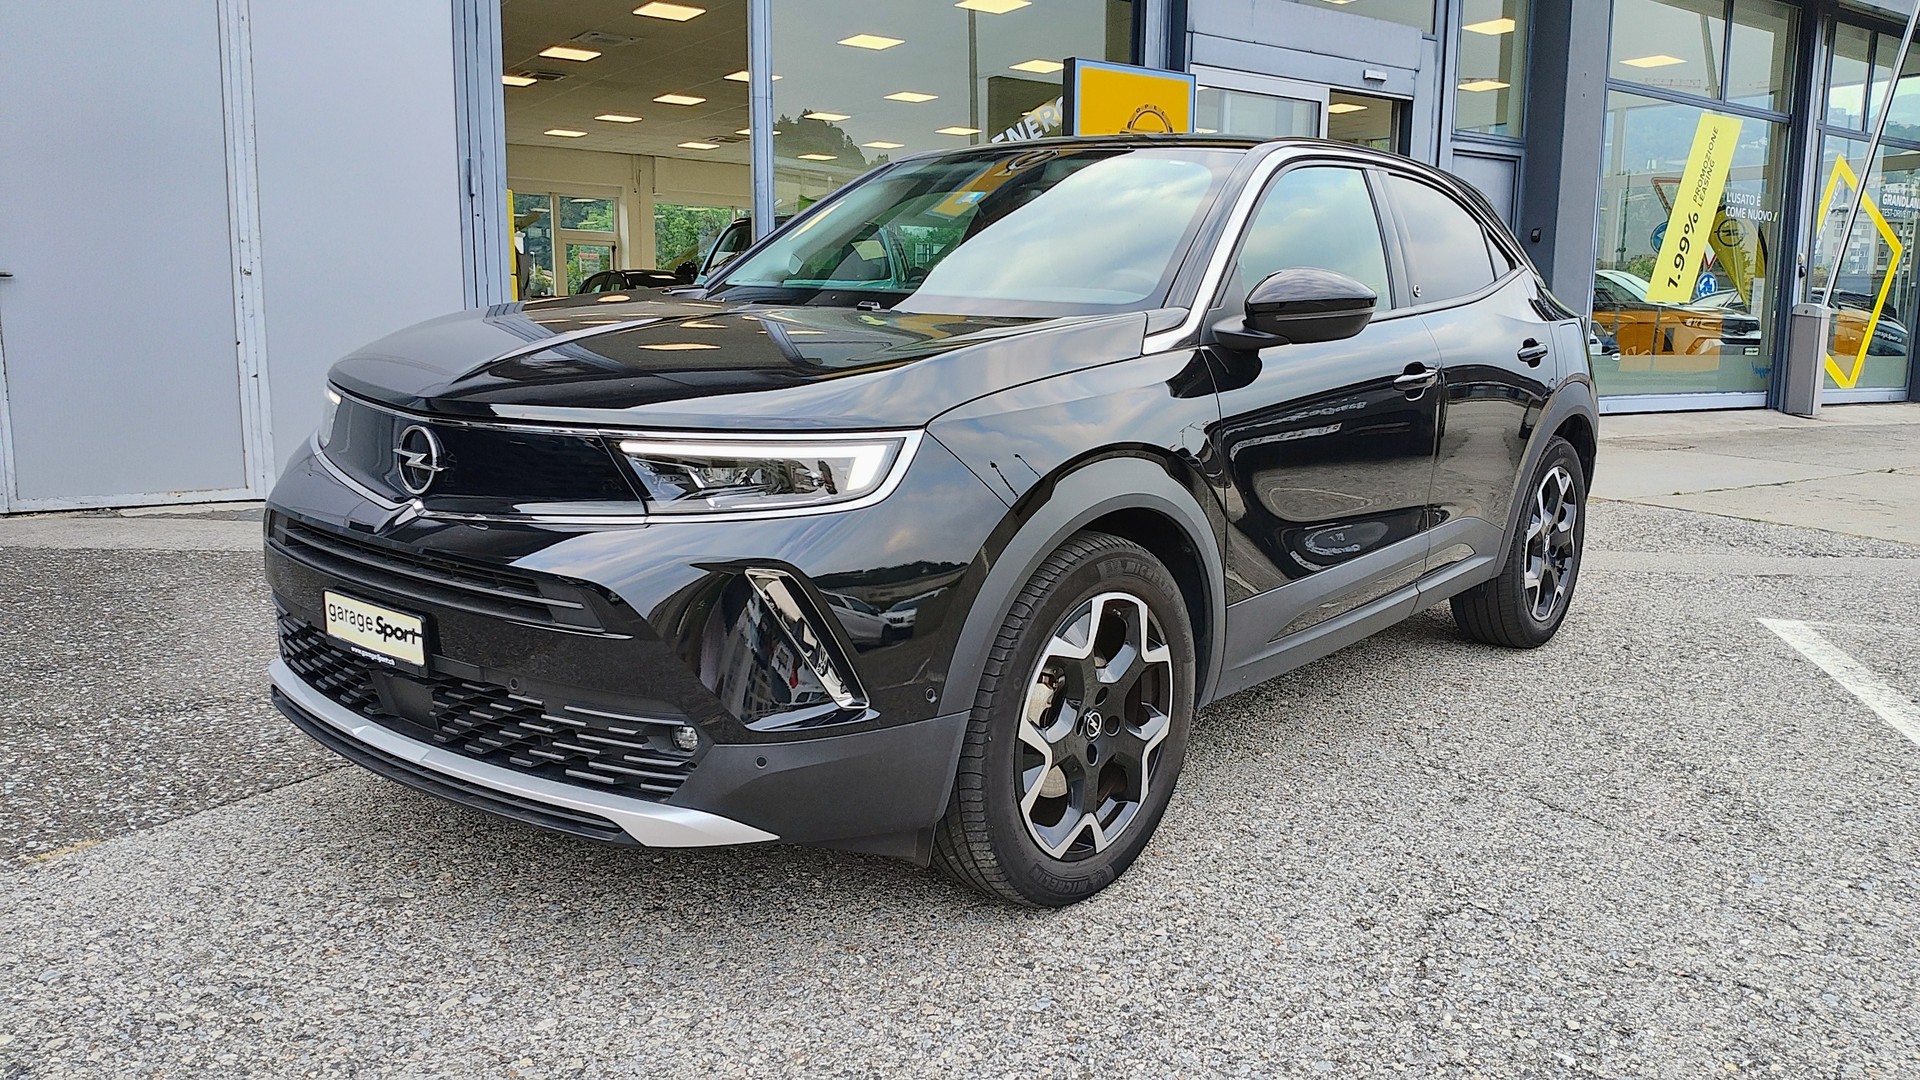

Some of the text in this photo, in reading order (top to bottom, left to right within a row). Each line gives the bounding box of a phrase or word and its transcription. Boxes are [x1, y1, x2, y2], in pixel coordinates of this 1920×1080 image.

[1692, 126, 1719, 204] PROMOZIONE
[1698, 159, 1716, 208] LEASING
[1726, 191, 1755, 206] L'USATO
[1725, 206, 1773, 222] COME NUOVO
[1882, 193, 1920, 210] GRANDLAN
[1667, 211, 1699, 289] 1.99%
